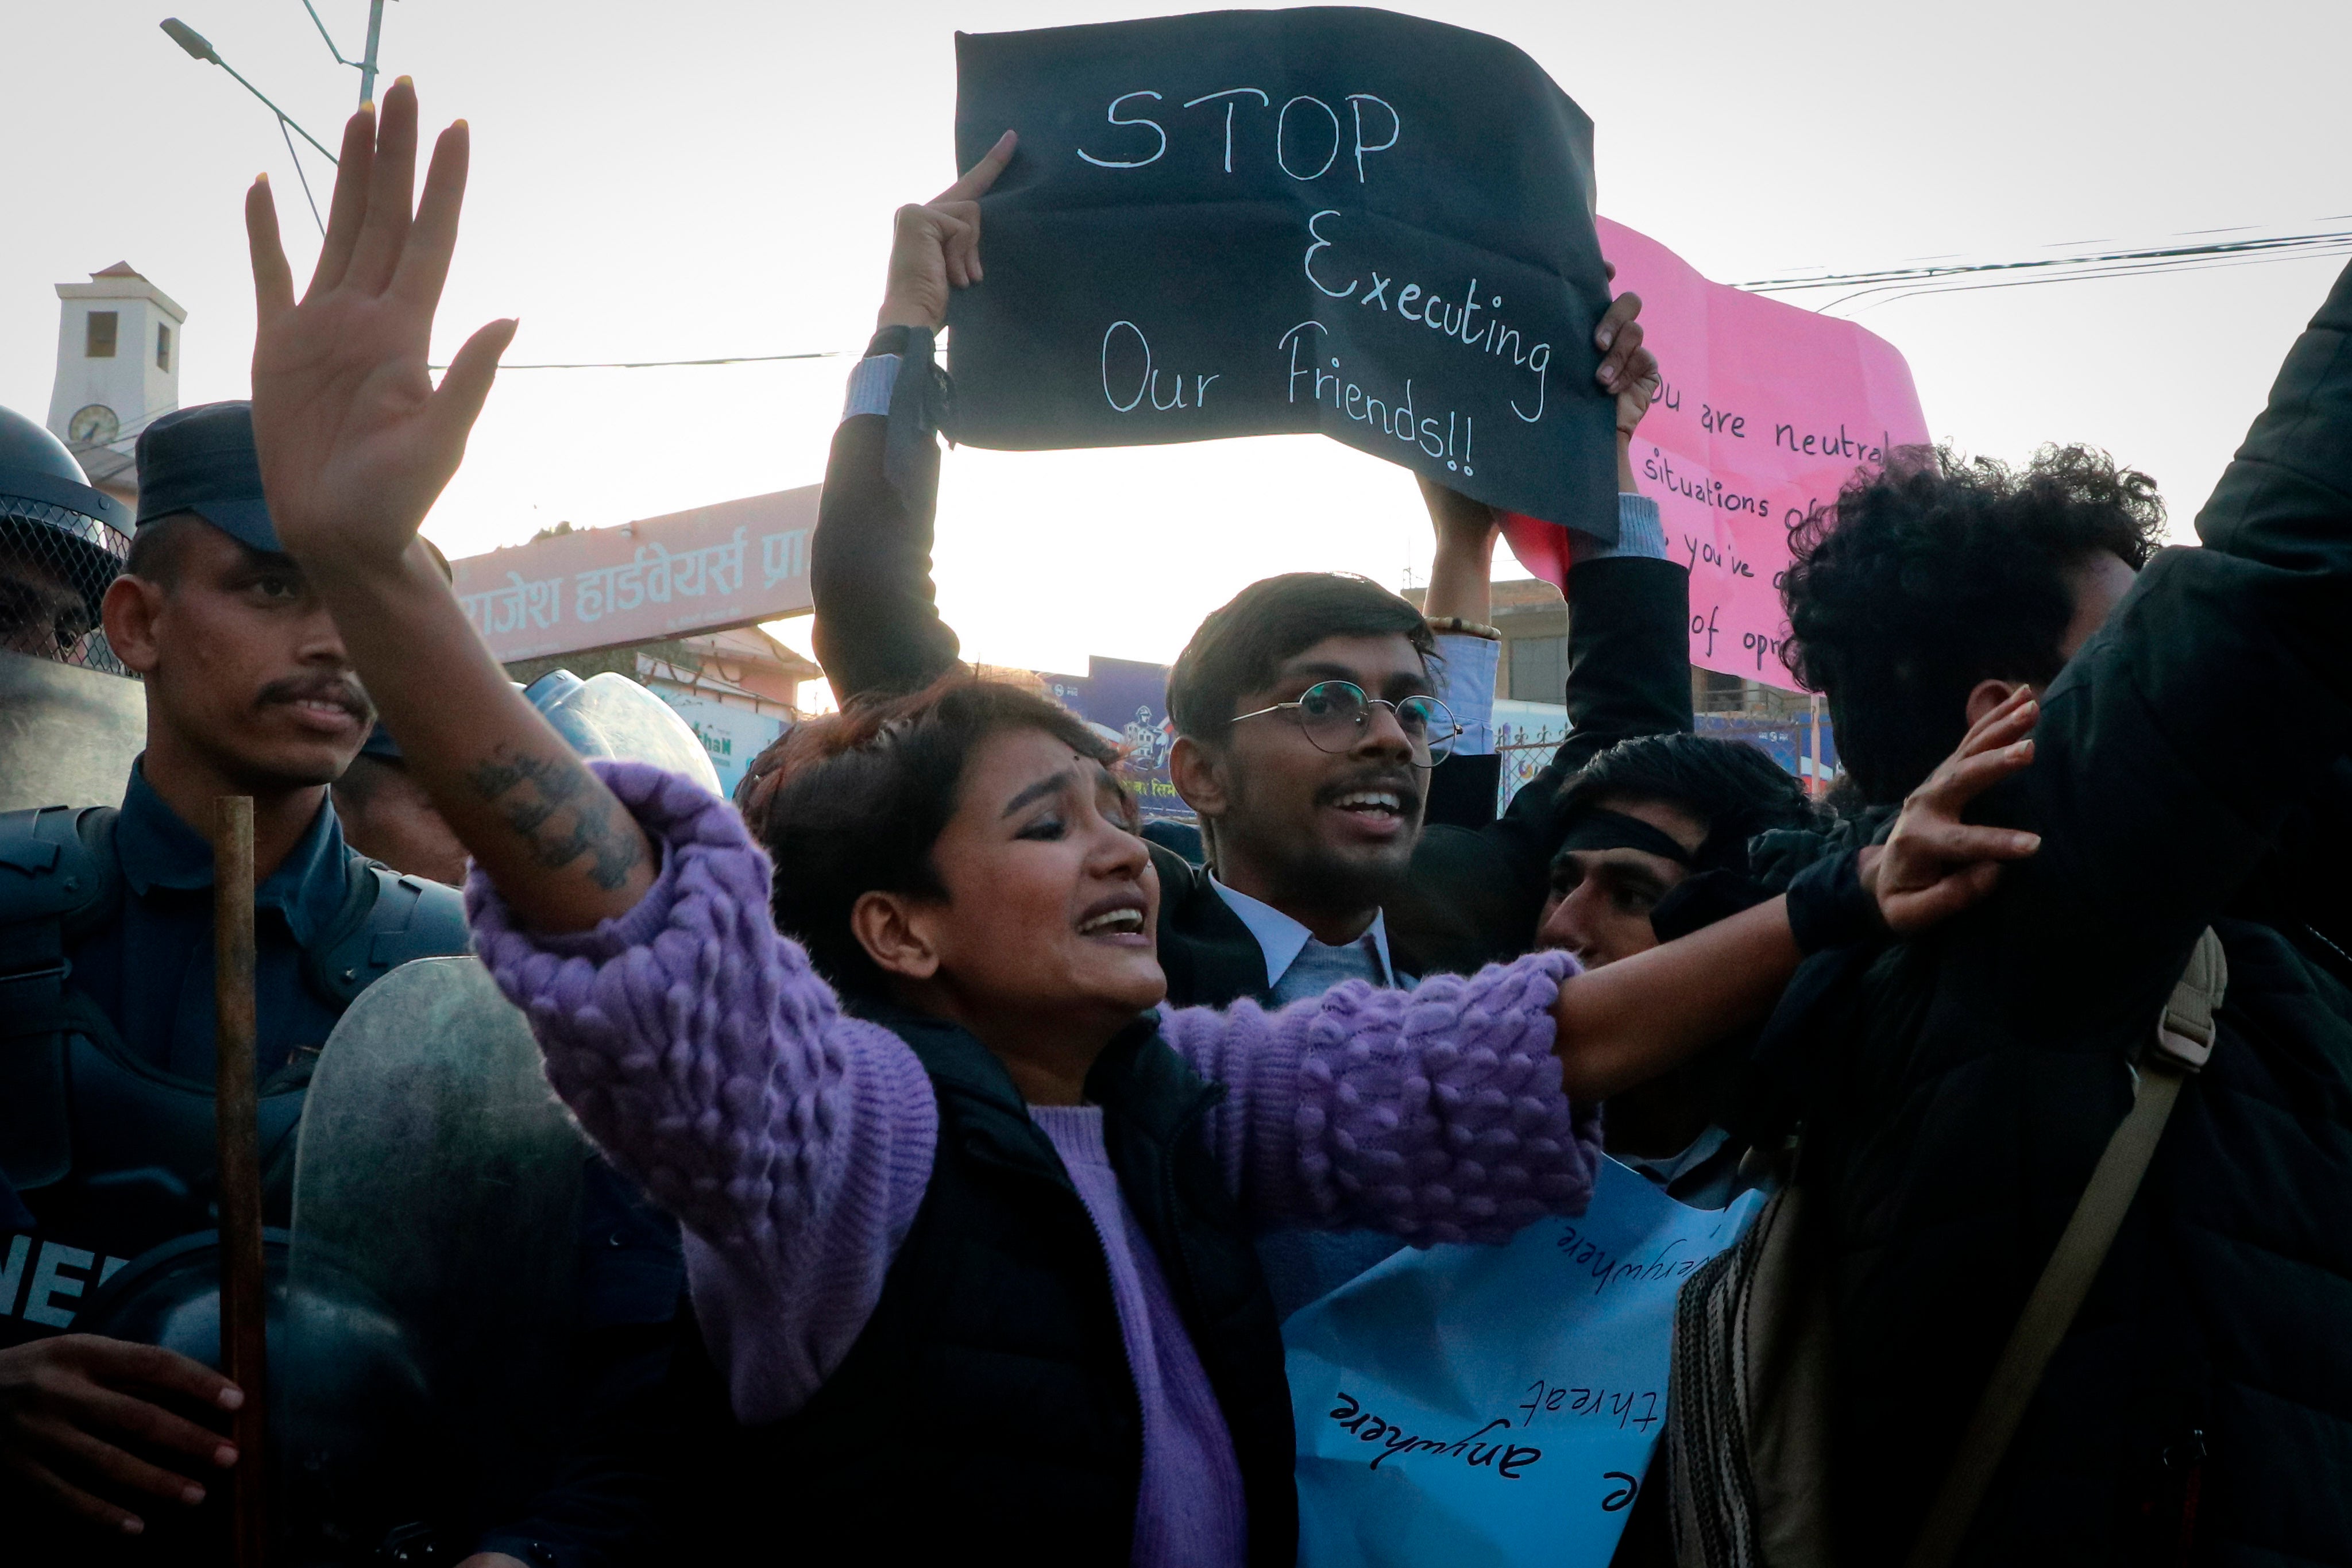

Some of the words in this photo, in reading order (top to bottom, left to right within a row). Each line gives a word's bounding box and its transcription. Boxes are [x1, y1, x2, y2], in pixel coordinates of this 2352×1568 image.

[1077, 87, 1400, 183] STOP
[1304, 210, 1551, 422] Executing
[1102, 321, 1219, 412] Our
[1279, 321, 1474, 476] Friends!!
[1702, 404, 1745, 438] are
[1643, 447, 1769, 517] situations
[1684, 534, 1755, 577] you've
[1691, 605, 1719, 658] of
[1557, 1226, 1710, 1296] verywhere
[1330, 1392, 1543, 1480] anywhere
[1519, 1380, 1658, 1432] threat
